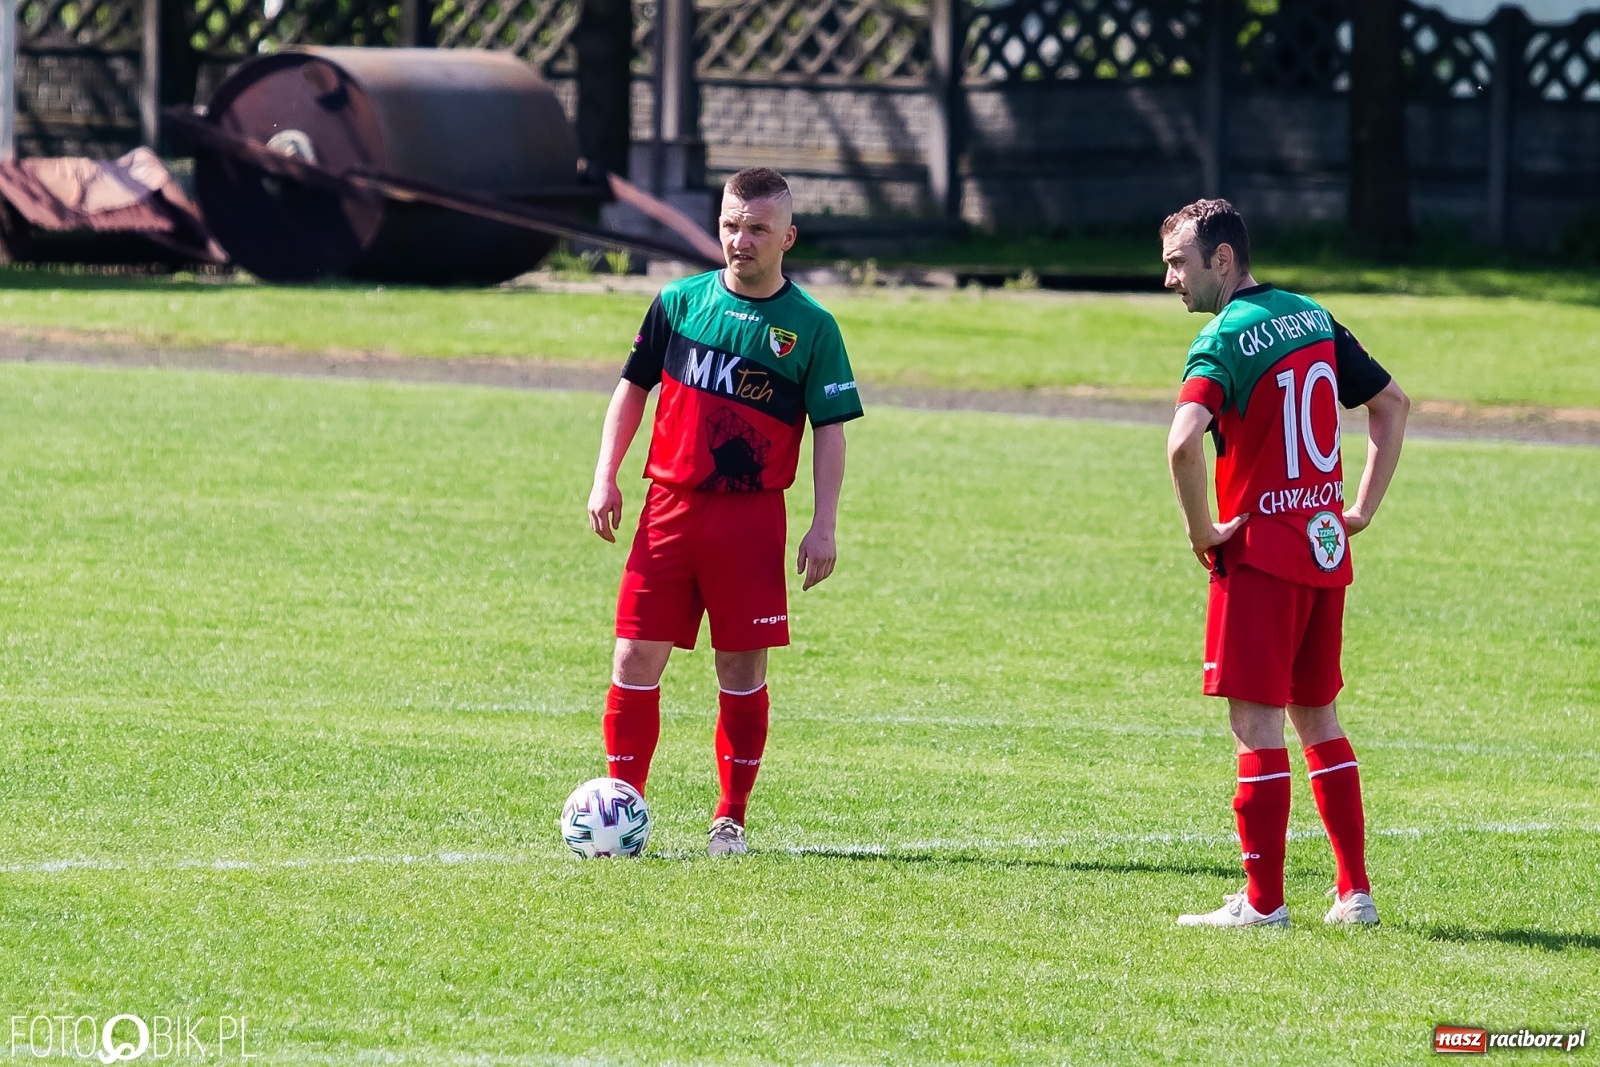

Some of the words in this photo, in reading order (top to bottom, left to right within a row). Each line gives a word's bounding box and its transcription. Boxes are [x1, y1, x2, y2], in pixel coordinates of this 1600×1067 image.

[1238, 321, 1275, 357] GKS
[1270, 308, 1333, 342] PIERWSZY
[682, 347, 741, 395] MK
[737, 368, 774, 403] Tech
[1276, 361, 1341, 481] 10
[753, 614, 787, 625] regio
